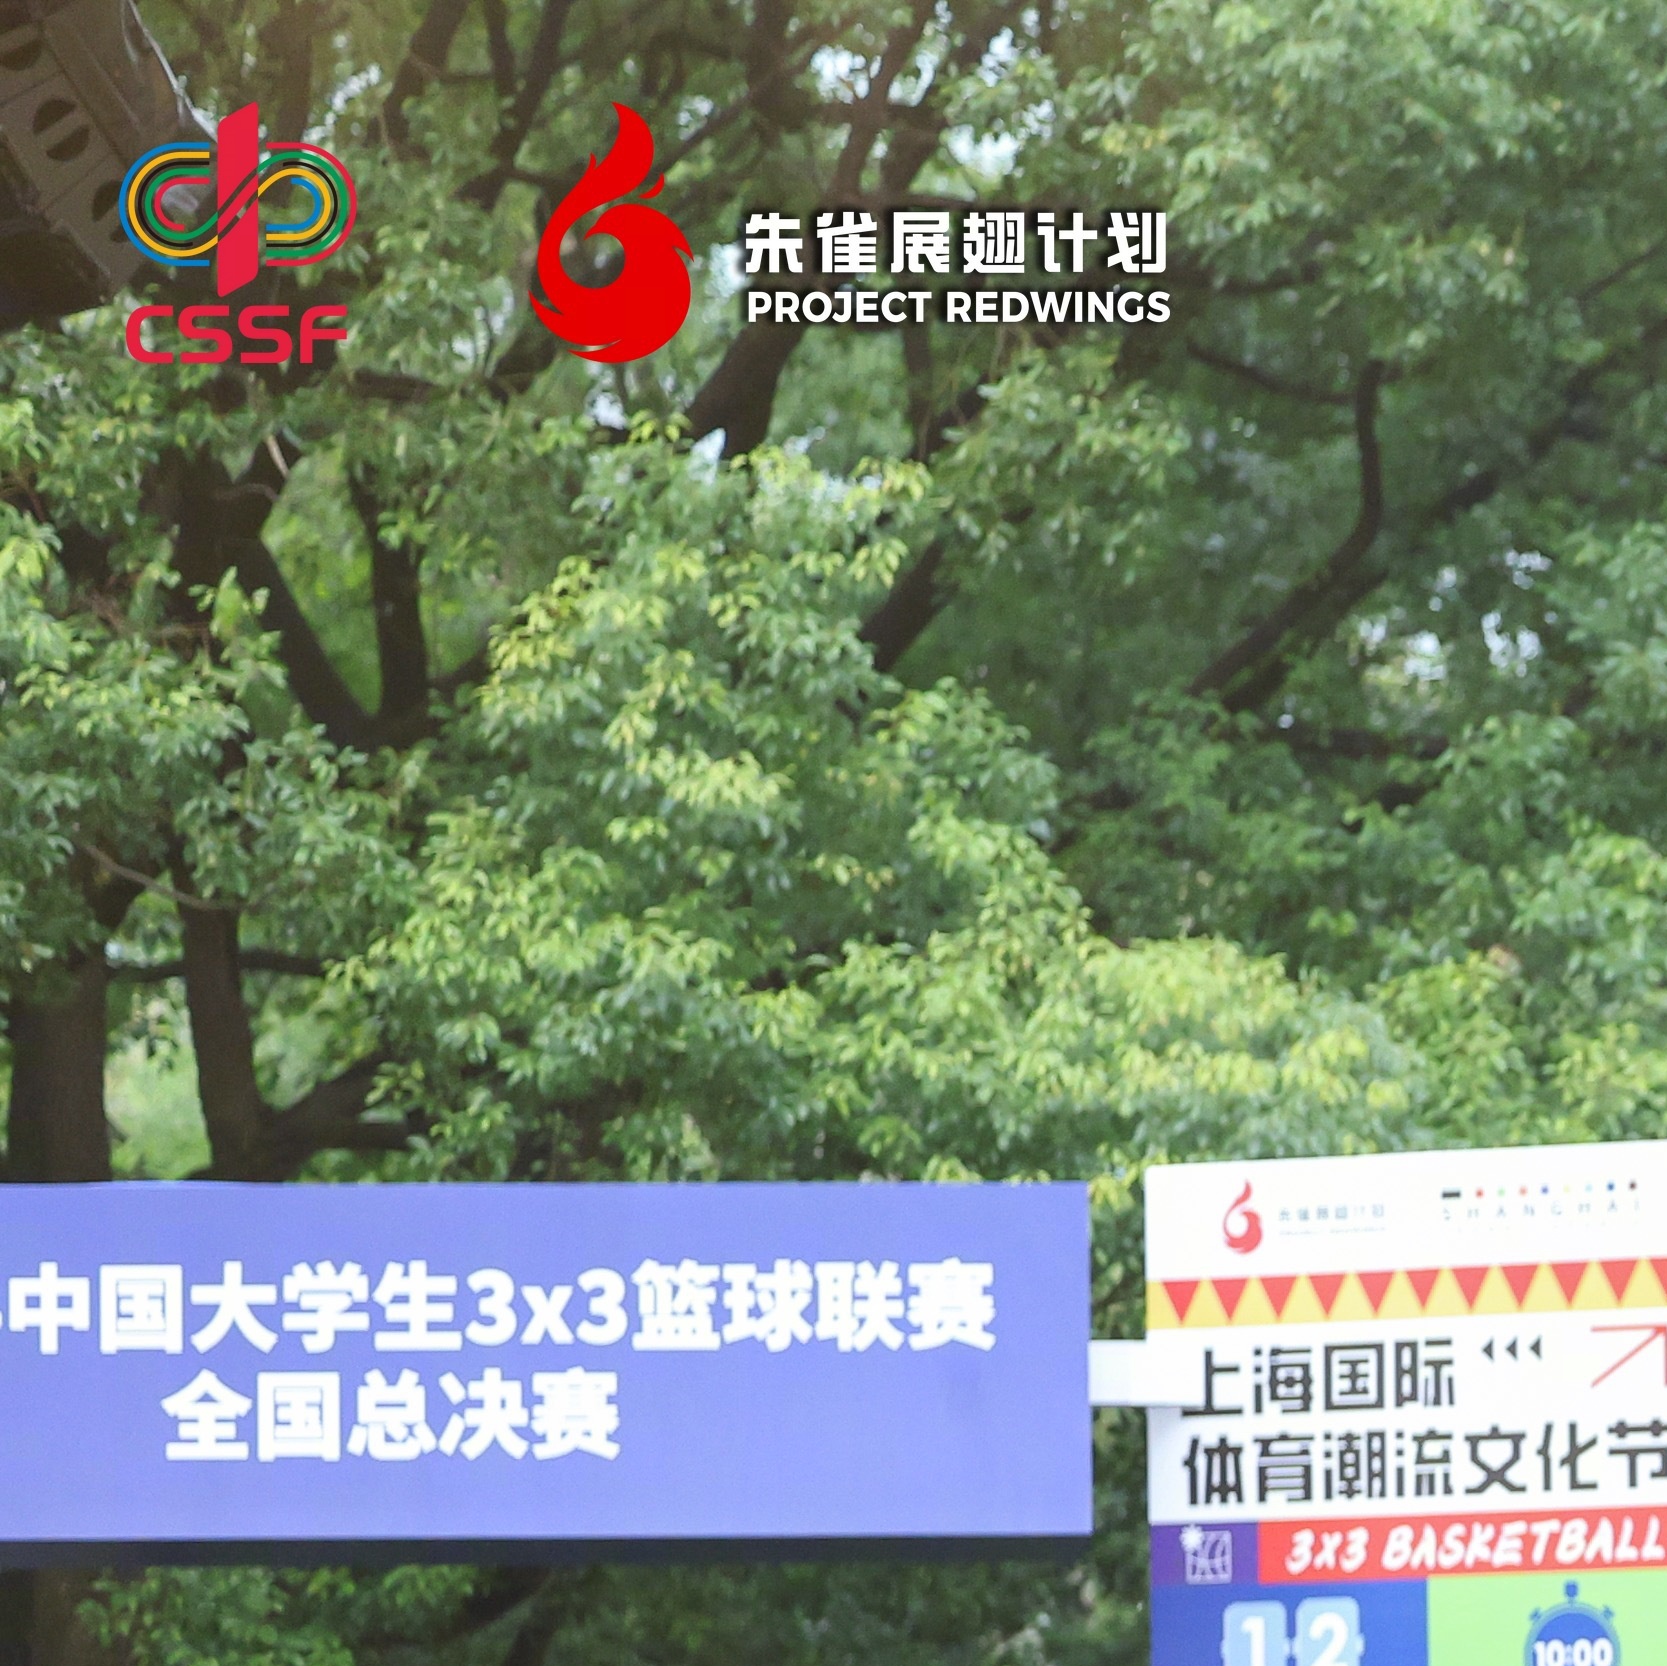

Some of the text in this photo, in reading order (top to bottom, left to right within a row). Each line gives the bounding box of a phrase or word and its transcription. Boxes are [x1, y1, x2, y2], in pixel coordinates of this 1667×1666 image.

[0, 1258, 996, 1356] 中国大学生3x3篮球联赛
[161, 1367, 620, 1462] 全国总决赛
[1181, 1337, 1456, 1417] 上海国际
[1382, 1516, 1667, 1570] BASKETBALL
